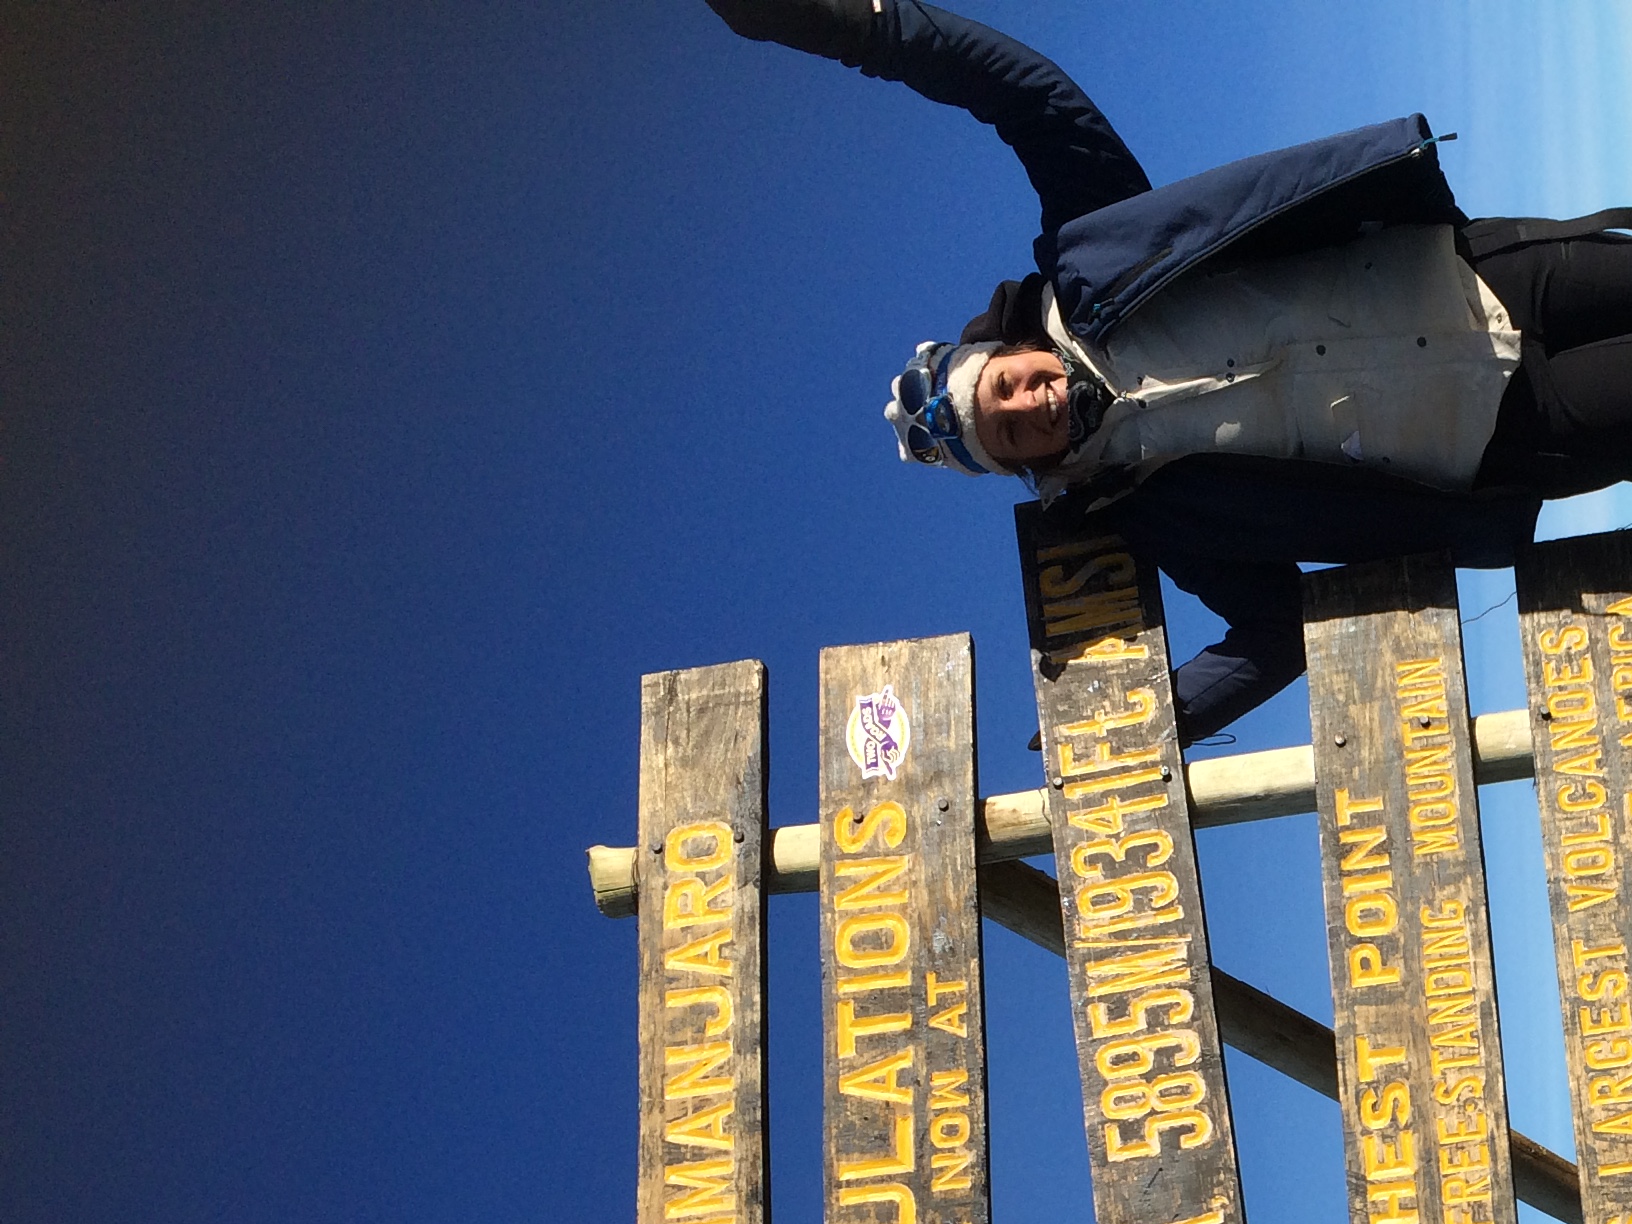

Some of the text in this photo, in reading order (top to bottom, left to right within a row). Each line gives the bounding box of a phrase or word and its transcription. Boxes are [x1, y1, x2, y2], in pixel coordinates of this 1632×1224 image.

[862, 707, 887, 765] TWO ROADS
[1397, 656, 1460, 854] MOUNTAIN
[1538, 624, 1618, 912] VOLCANOES
[1335, 788, 1401, 988] POINT
[926, 971, 968, 1037] AT
[929, 1069, 971, 1191] NOW
